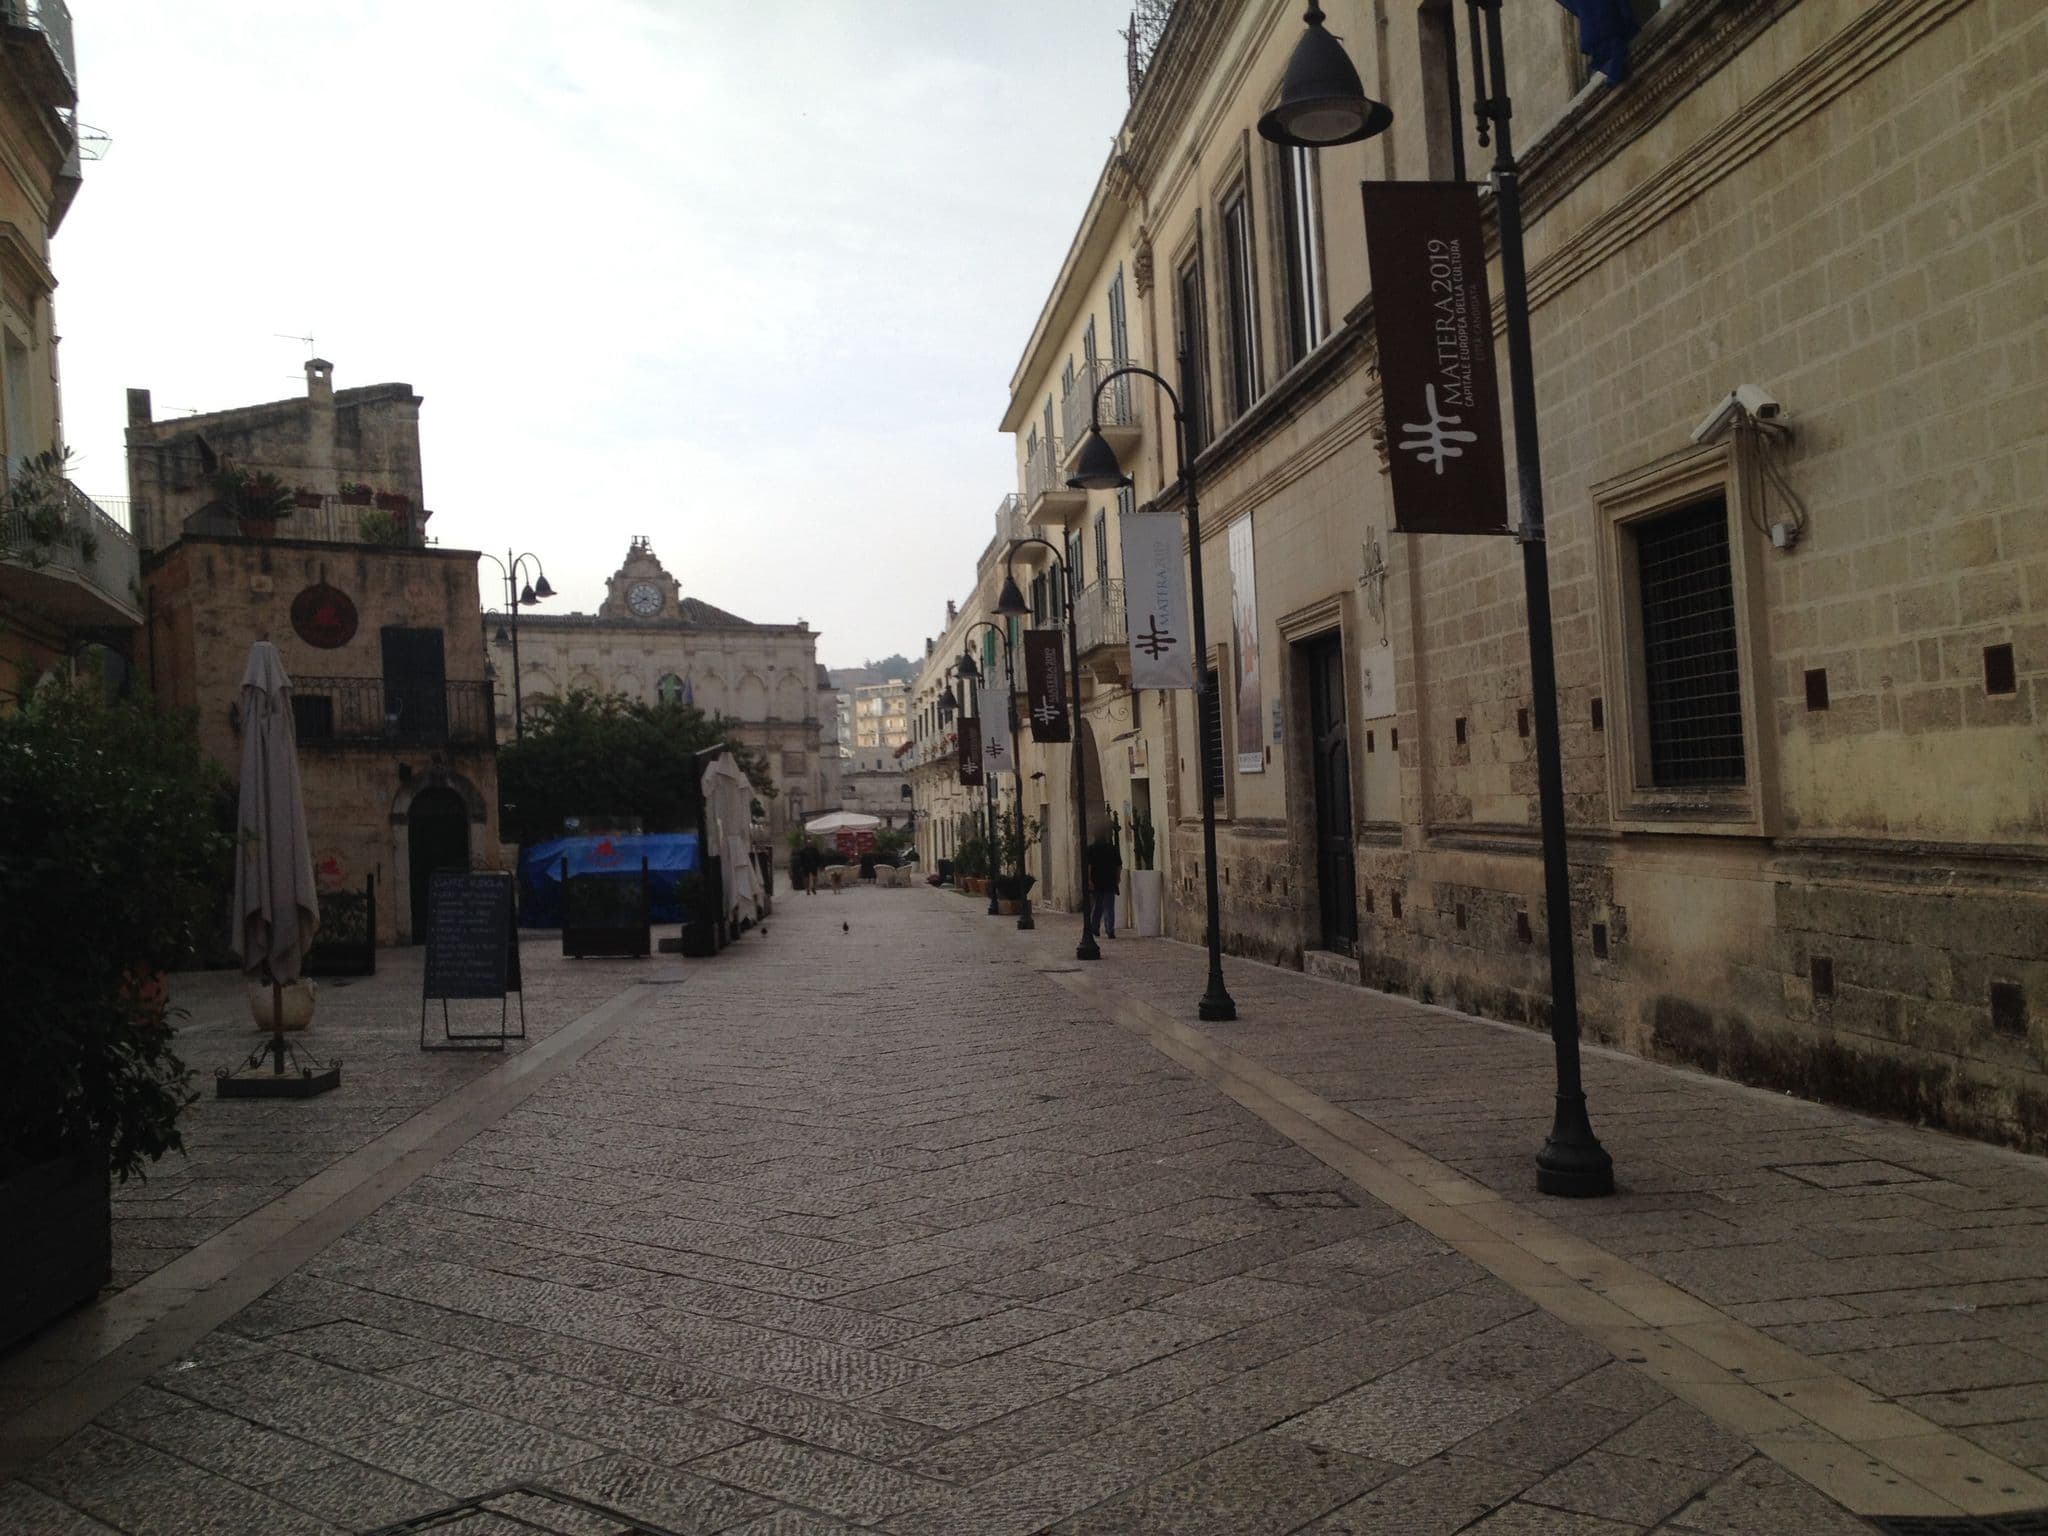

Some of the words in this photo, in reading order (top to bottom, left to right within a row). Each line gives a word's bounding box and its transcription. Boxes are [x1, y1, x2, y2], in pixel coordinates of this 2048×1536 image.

[1450, 239, 1464, 282] CULTURA
[1454, 283, 1466, 314] DELLA
[1457, 315, 1471, 361] EUROPEA
[1461, 362, 1474, 408] CAPITALE
